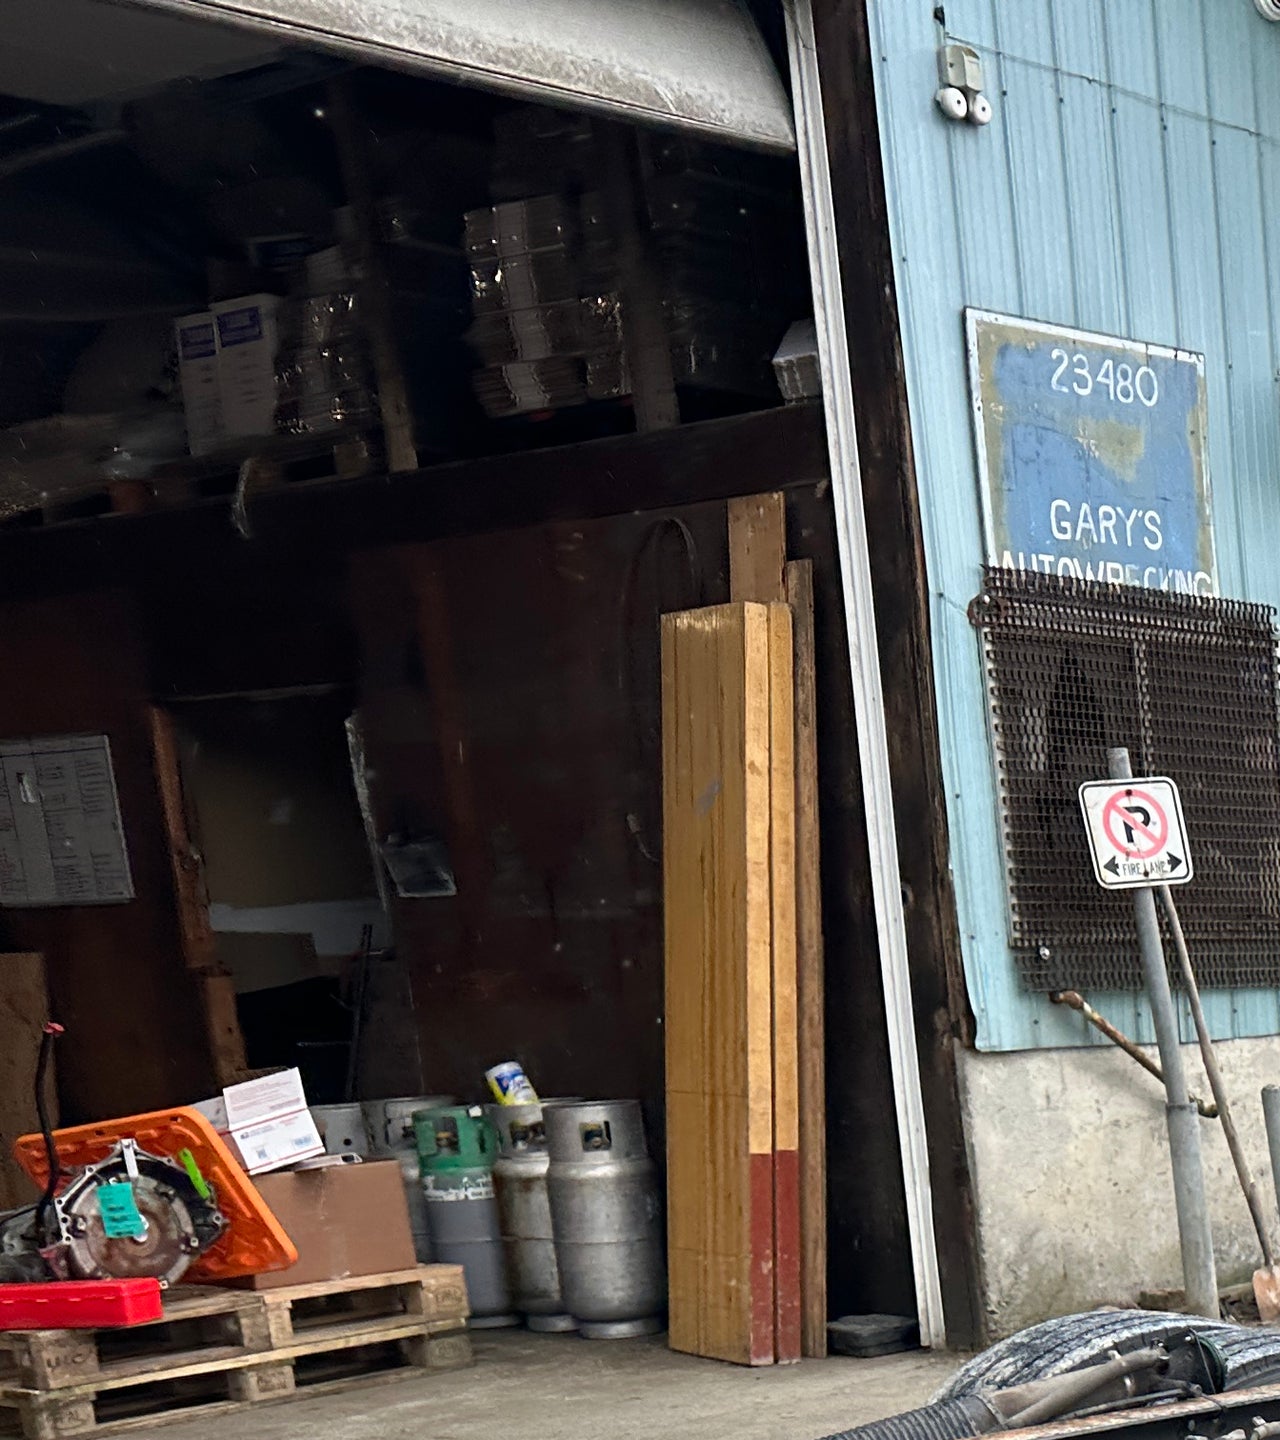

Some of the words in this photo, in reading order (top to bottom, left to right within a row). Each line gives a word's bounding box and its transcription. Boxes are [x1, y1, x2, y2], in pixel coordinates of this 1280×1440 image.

[1051, 348, 1158, 407] 23480
[1050, 499, 1162, 551] GARY'S
[1122, 863, 1142, 876] FIRE
